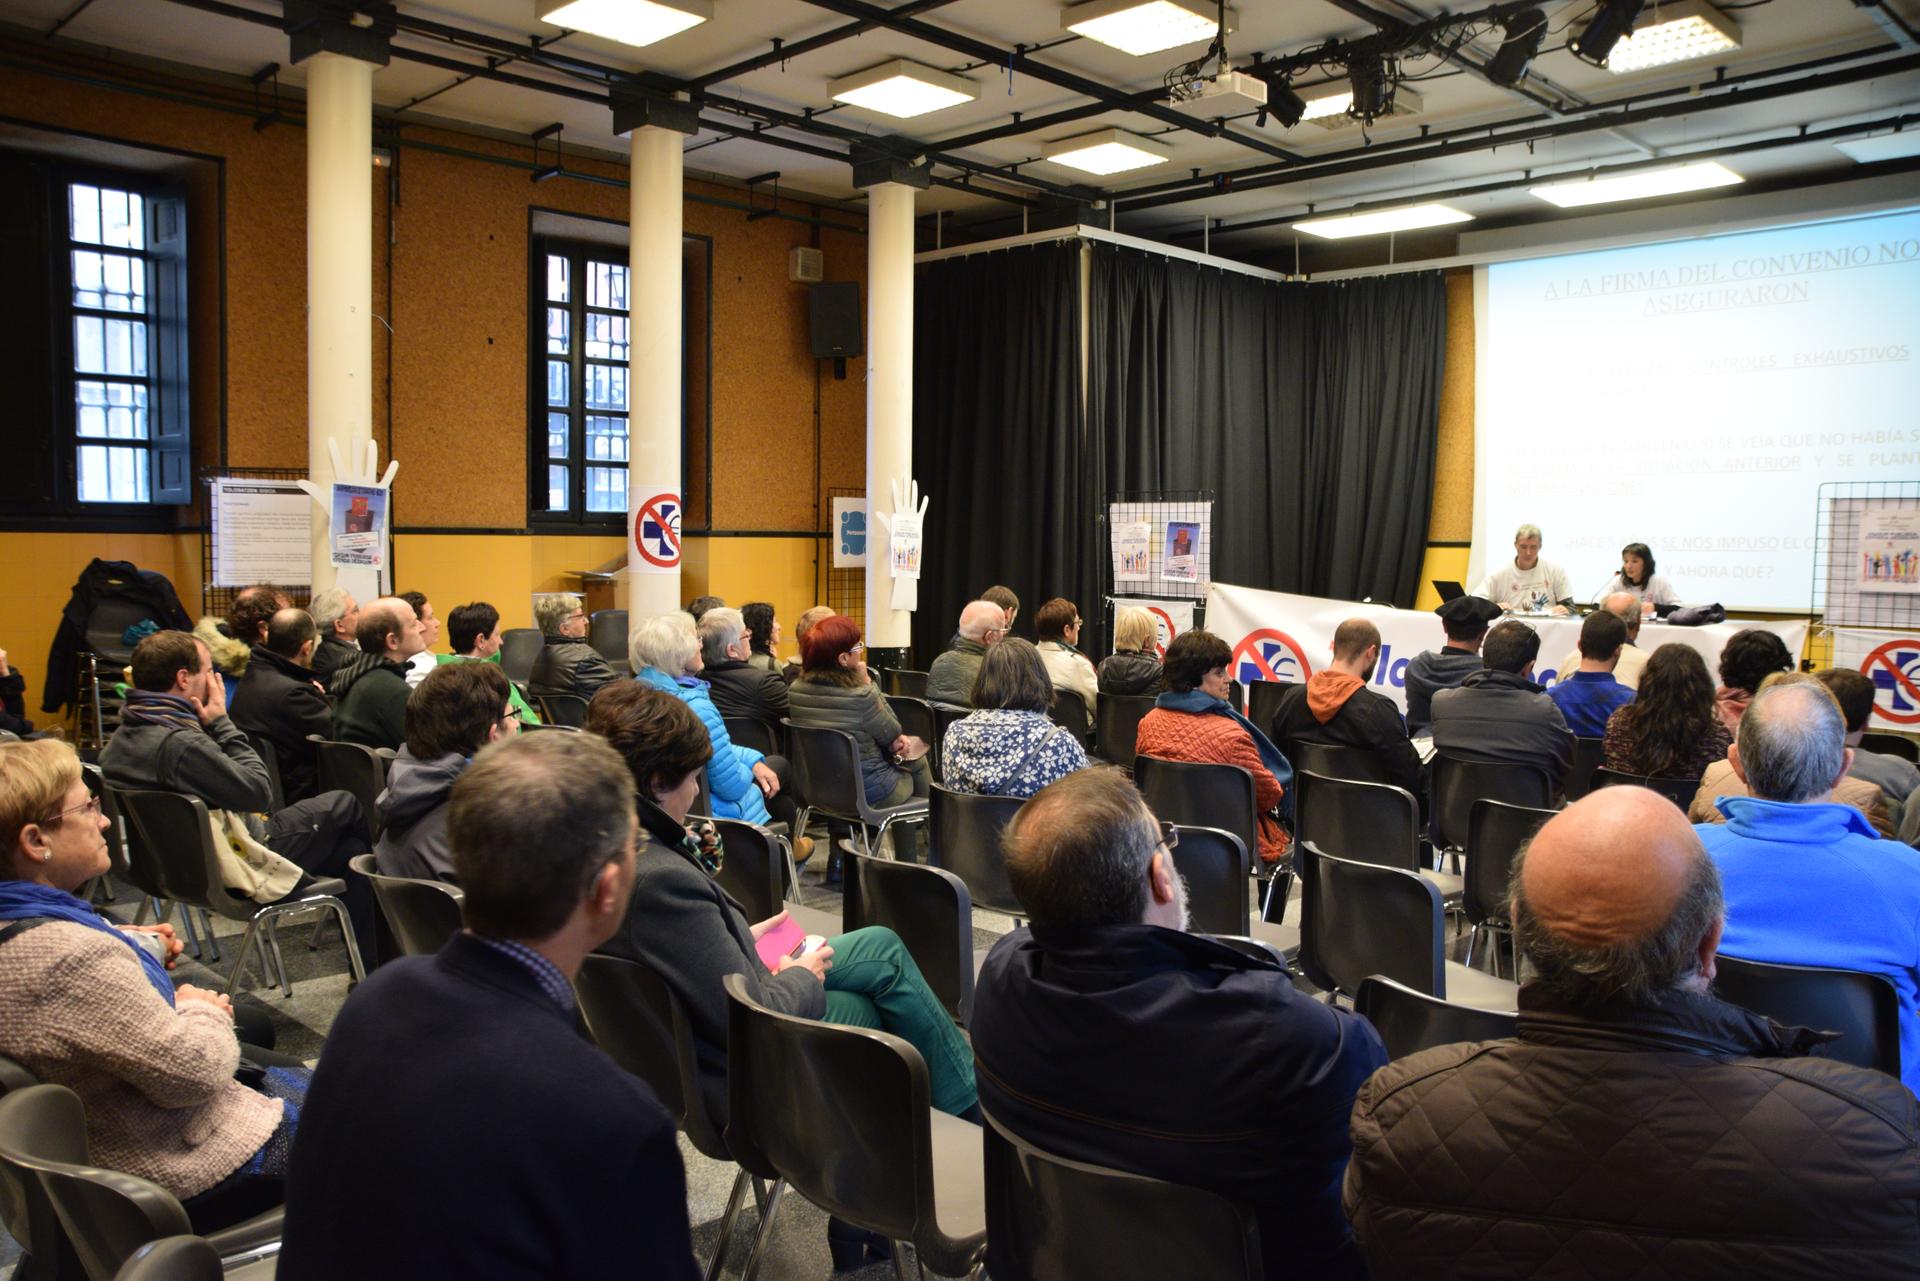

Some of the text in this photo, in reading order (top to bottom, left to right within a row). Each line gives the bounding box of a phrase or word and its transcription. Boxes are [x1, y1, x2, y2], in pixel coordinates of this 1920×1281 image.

[1543, 238, 1920, 300] A LA FIRMA DEL CONVENIO NO
[1641, 280, 1809, 317] ASEGURARON
[1793, 343, 1911, 366] EXHAUSTIVOS
[1779, 432, 1818, 449] QUE
[1819, 431, 1846, 447] NO
[1723, 454, 1801, 472] ANTERIOR
[1837, 453, 1857, 467] SE
[1681, 536, 1713, 550] NOS
[1716, 535, 1779, 551] IMPUSO
[1676, 564, 1730, 579] AHORA
